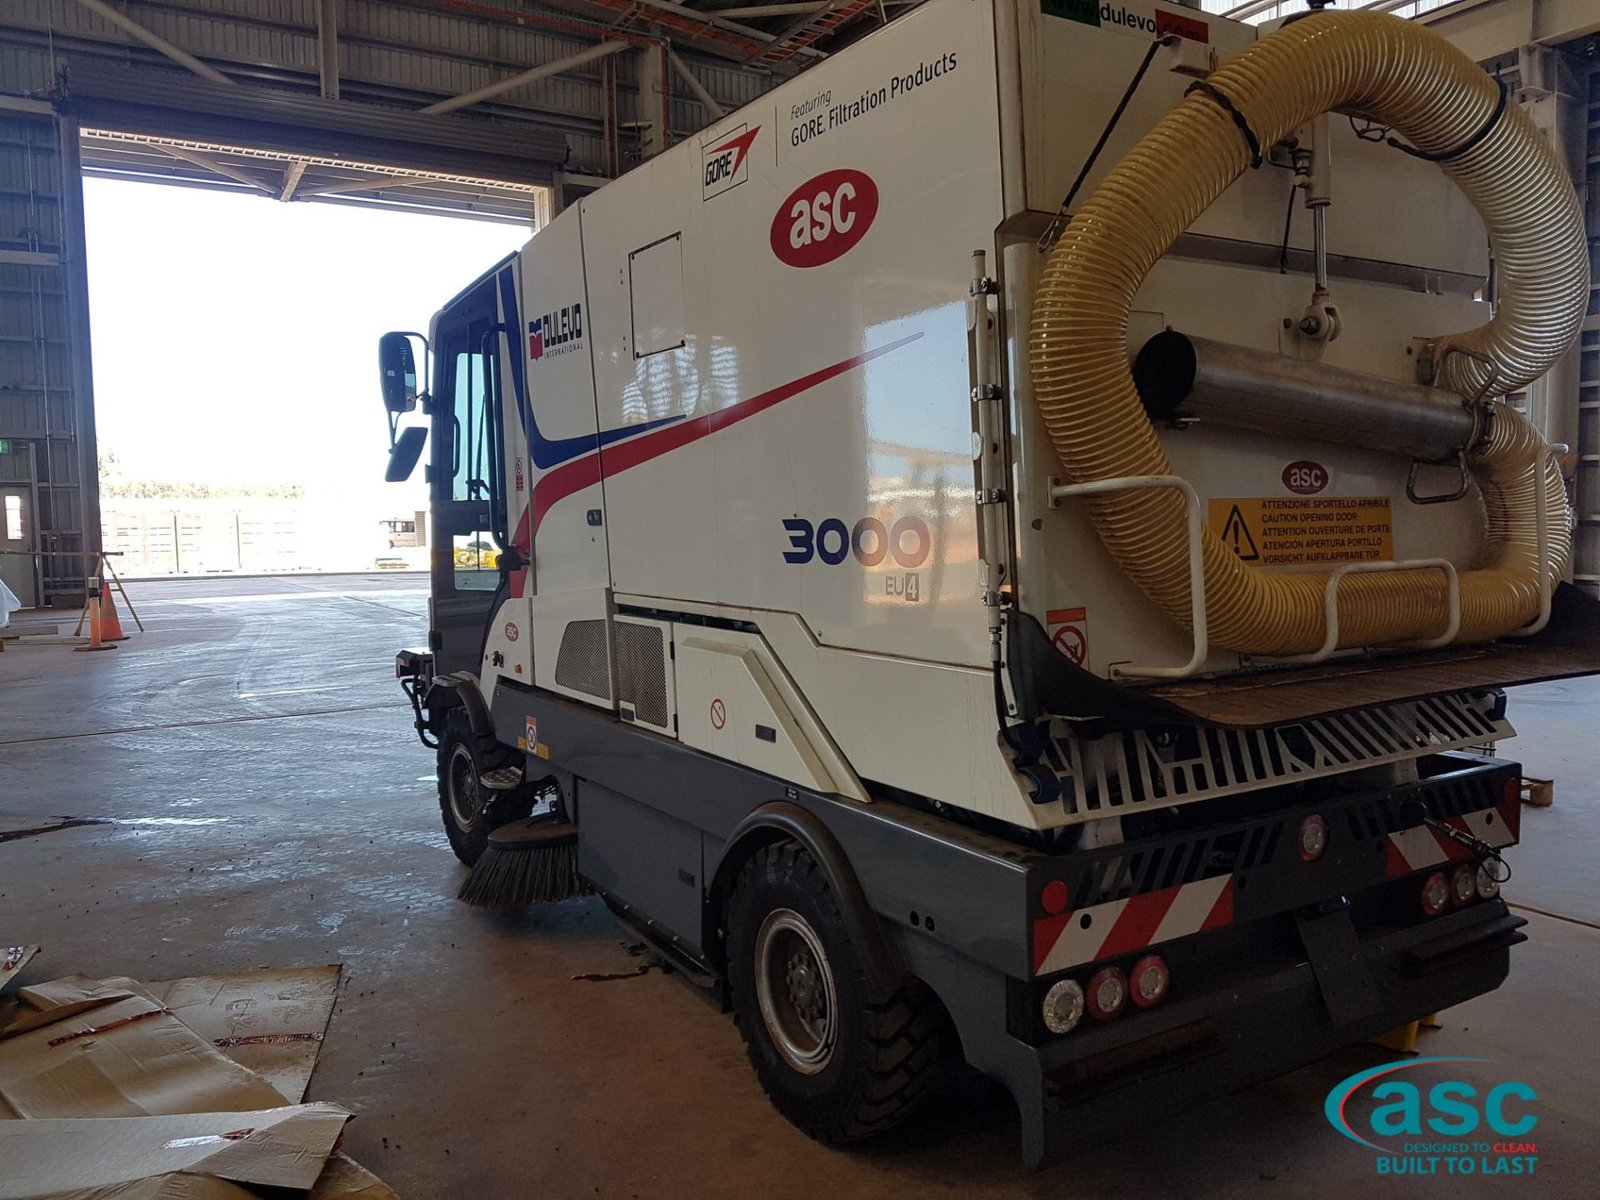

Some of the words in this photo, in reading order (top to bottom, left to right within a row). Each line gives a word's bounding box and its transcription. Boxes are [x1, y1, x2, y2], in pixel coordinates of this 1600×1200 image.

[829, 88, 887, 130] Filtration
[891, 52, 957, 99] Products
[791, 89, 832, 121] Featuring
[705, 151, 733, 187] GORE
[789, 182, 856, 249] asc
[543, 303, 583, 349] DULEVO
[544, 344, 584, 360] INTERNATIONAL
[1290, 468, 1322, 487] asc
[1261, 500, 1311, 510] ATTENZIONE
[1312, 499, 1357, 509] SPORTELLO
[1261, 513, 1298, 523] CAUTION
[1300, 513, 1334, 522] OPENING
[1336, 512, 1358, 521] DOOR
[1262, 527, 1308, 537] ATTENTION
[1309, 525, 1354, 535] OUVERTURE
[1356, 525, 1366, 534] DE
[1367, 524, 1391, 533] PORTE
[782, 516, 931, 568] 3000
[1305, 539, 1345, 549] APERTURA
[1347, 537, 1382, 547] PORTILLO
[1263, 553, 1303, 564] VORSICHT
[1306, 551, 1364, 561] AUFKLAPPBARE
